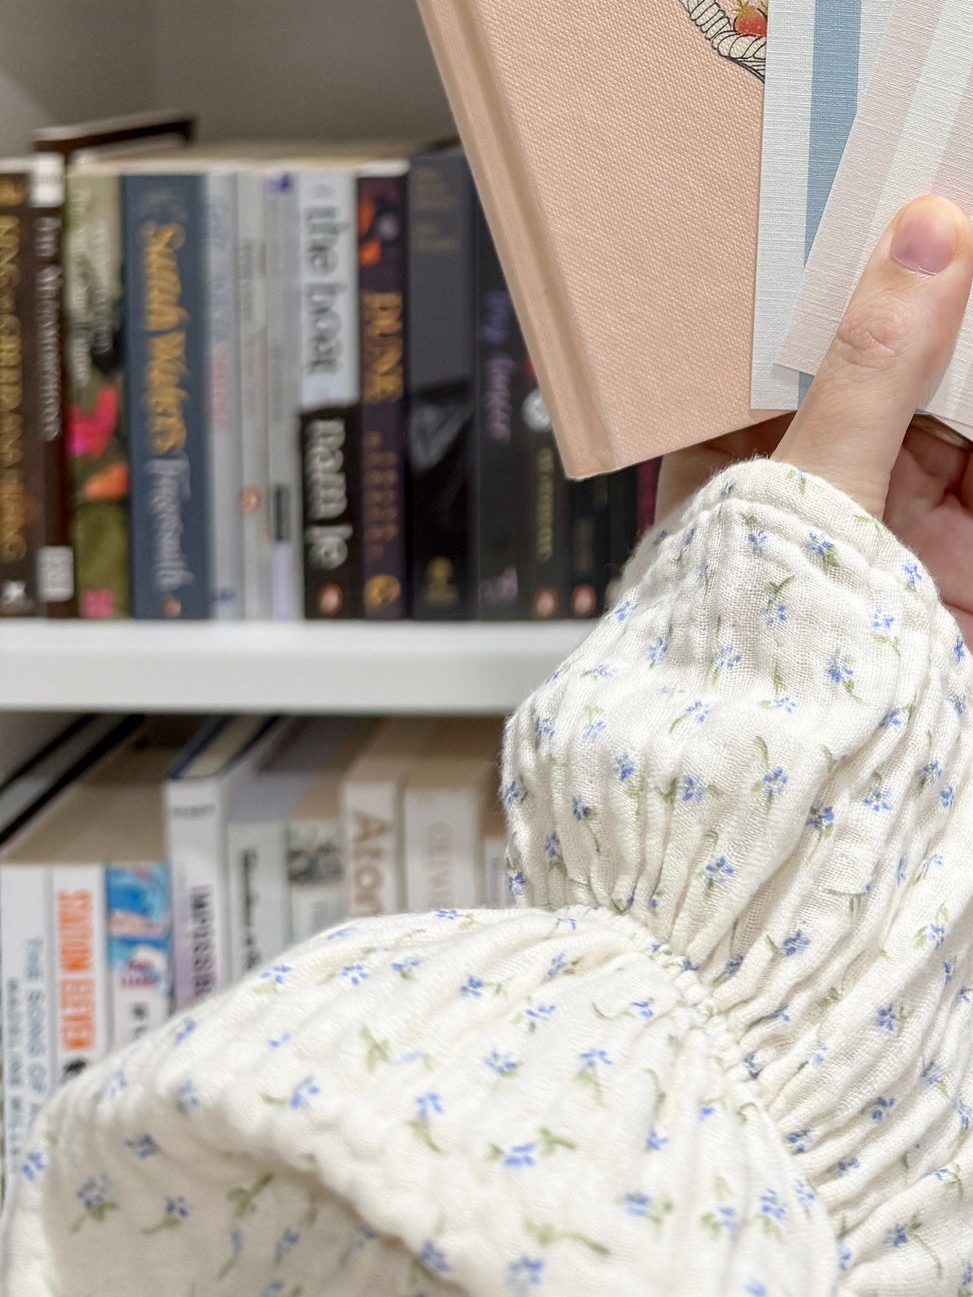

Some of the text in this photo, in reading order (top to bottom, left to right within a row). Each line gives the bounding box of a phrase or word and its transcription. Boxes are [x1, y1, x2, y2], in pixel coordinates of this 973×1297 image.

[361, 291, 403, 404] DUNE
[26, 989, 46, 1056] SONG
[57, 889, 95, 1051] STATION ELEVEN
